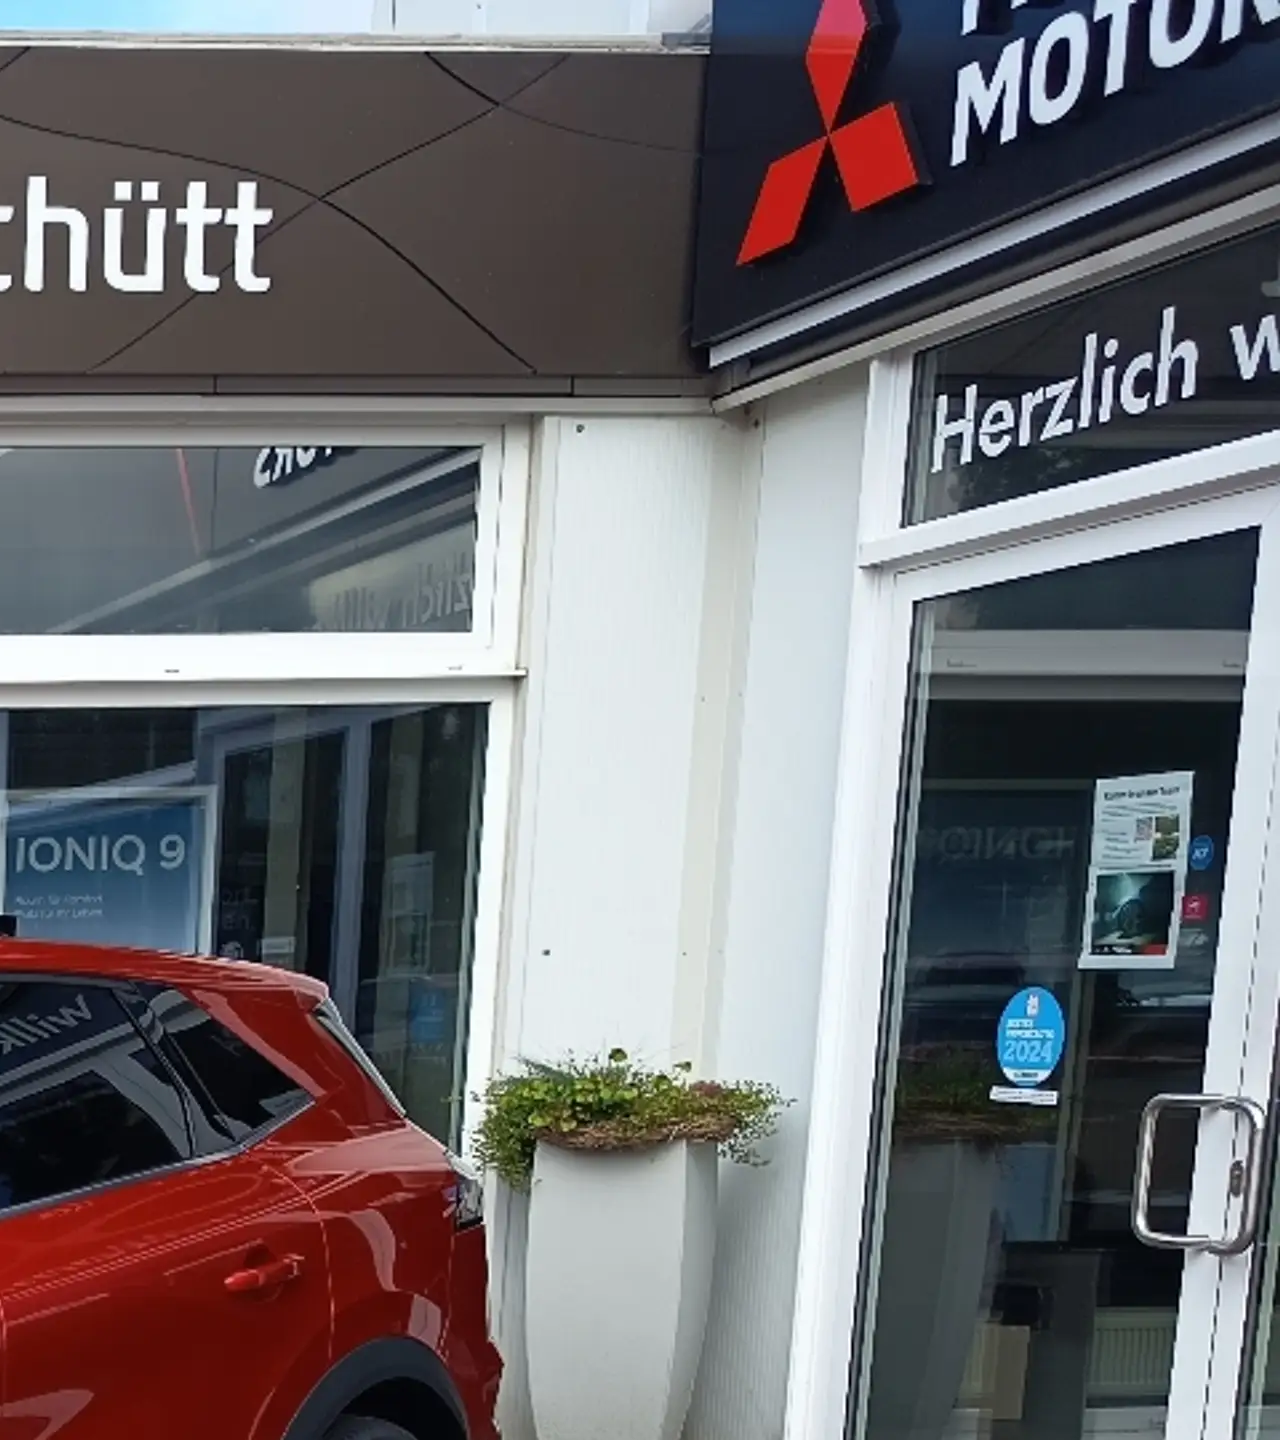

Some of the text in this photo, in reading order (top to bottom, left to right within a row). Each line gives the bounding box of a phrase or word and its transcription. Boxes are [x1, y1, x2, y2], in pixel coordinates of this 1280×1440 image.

[931, 306, 1199, 473] Herzlich
[15, 834, 186, 875] IONIQ 9
[1003, 1039, 1053, 1062] 2024
